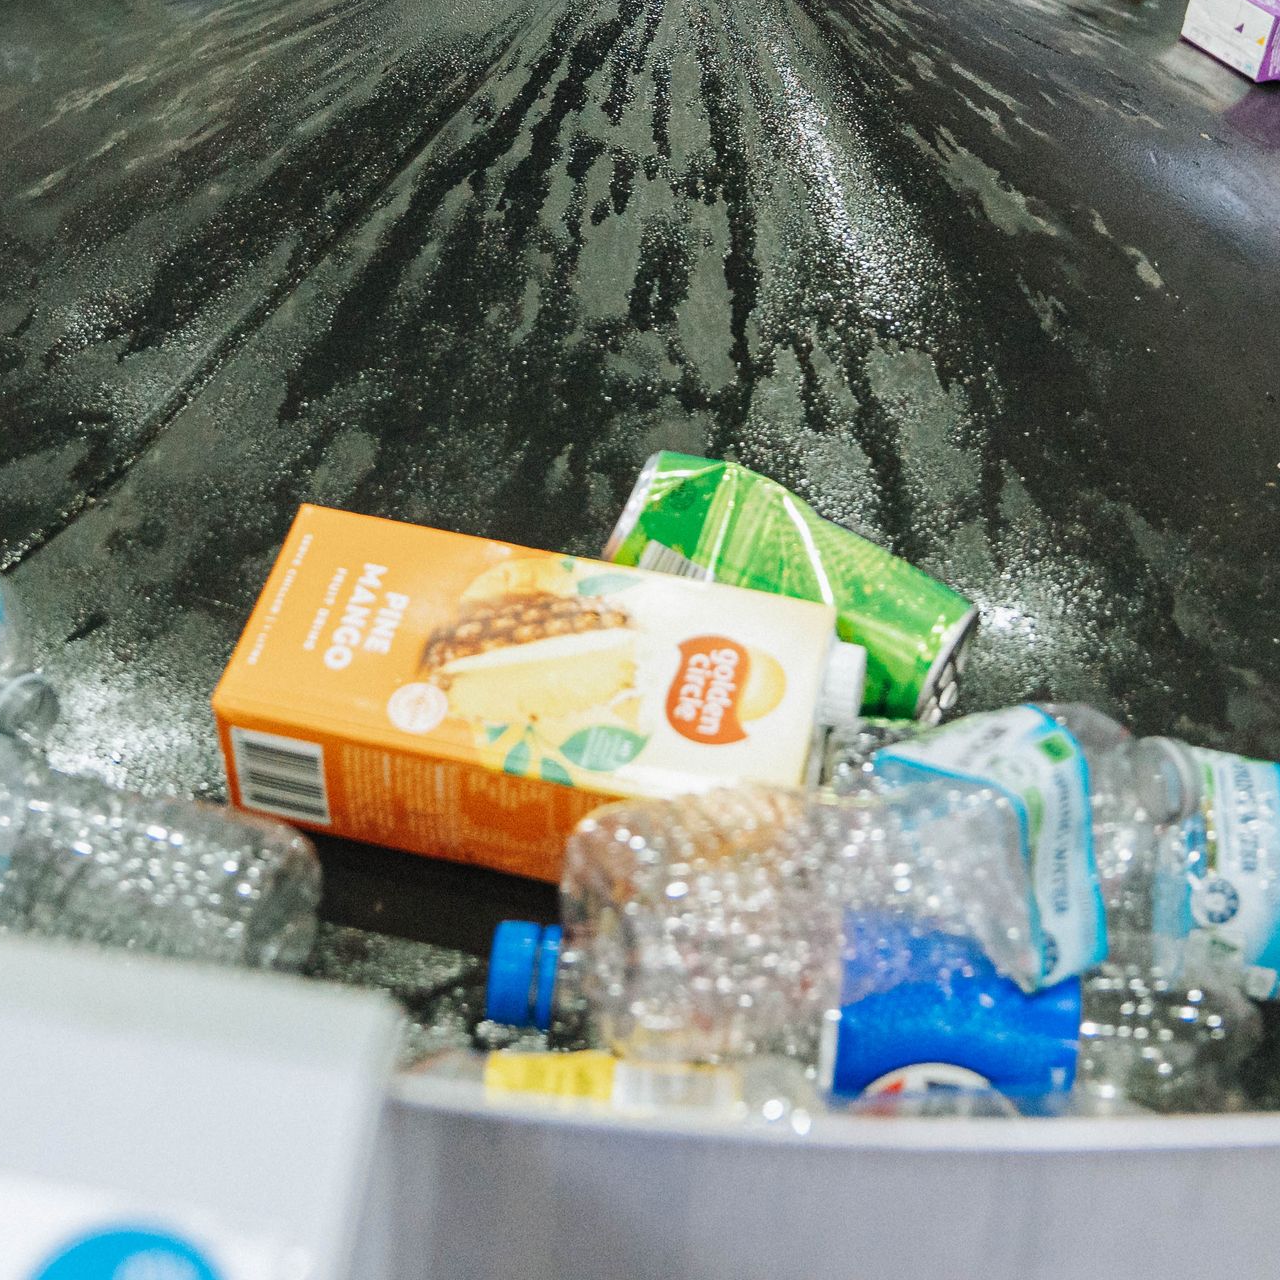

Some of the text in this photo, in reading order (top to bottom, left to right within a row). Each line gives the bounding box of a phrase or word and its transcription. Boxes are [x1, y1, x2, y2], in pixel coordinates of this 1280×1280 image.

[323, 562, 389, 671] MANGO
[363, 591, 411, 655] PINE
[672, 652, 712, 723] circle
[696, 647, 740, 737] golden
